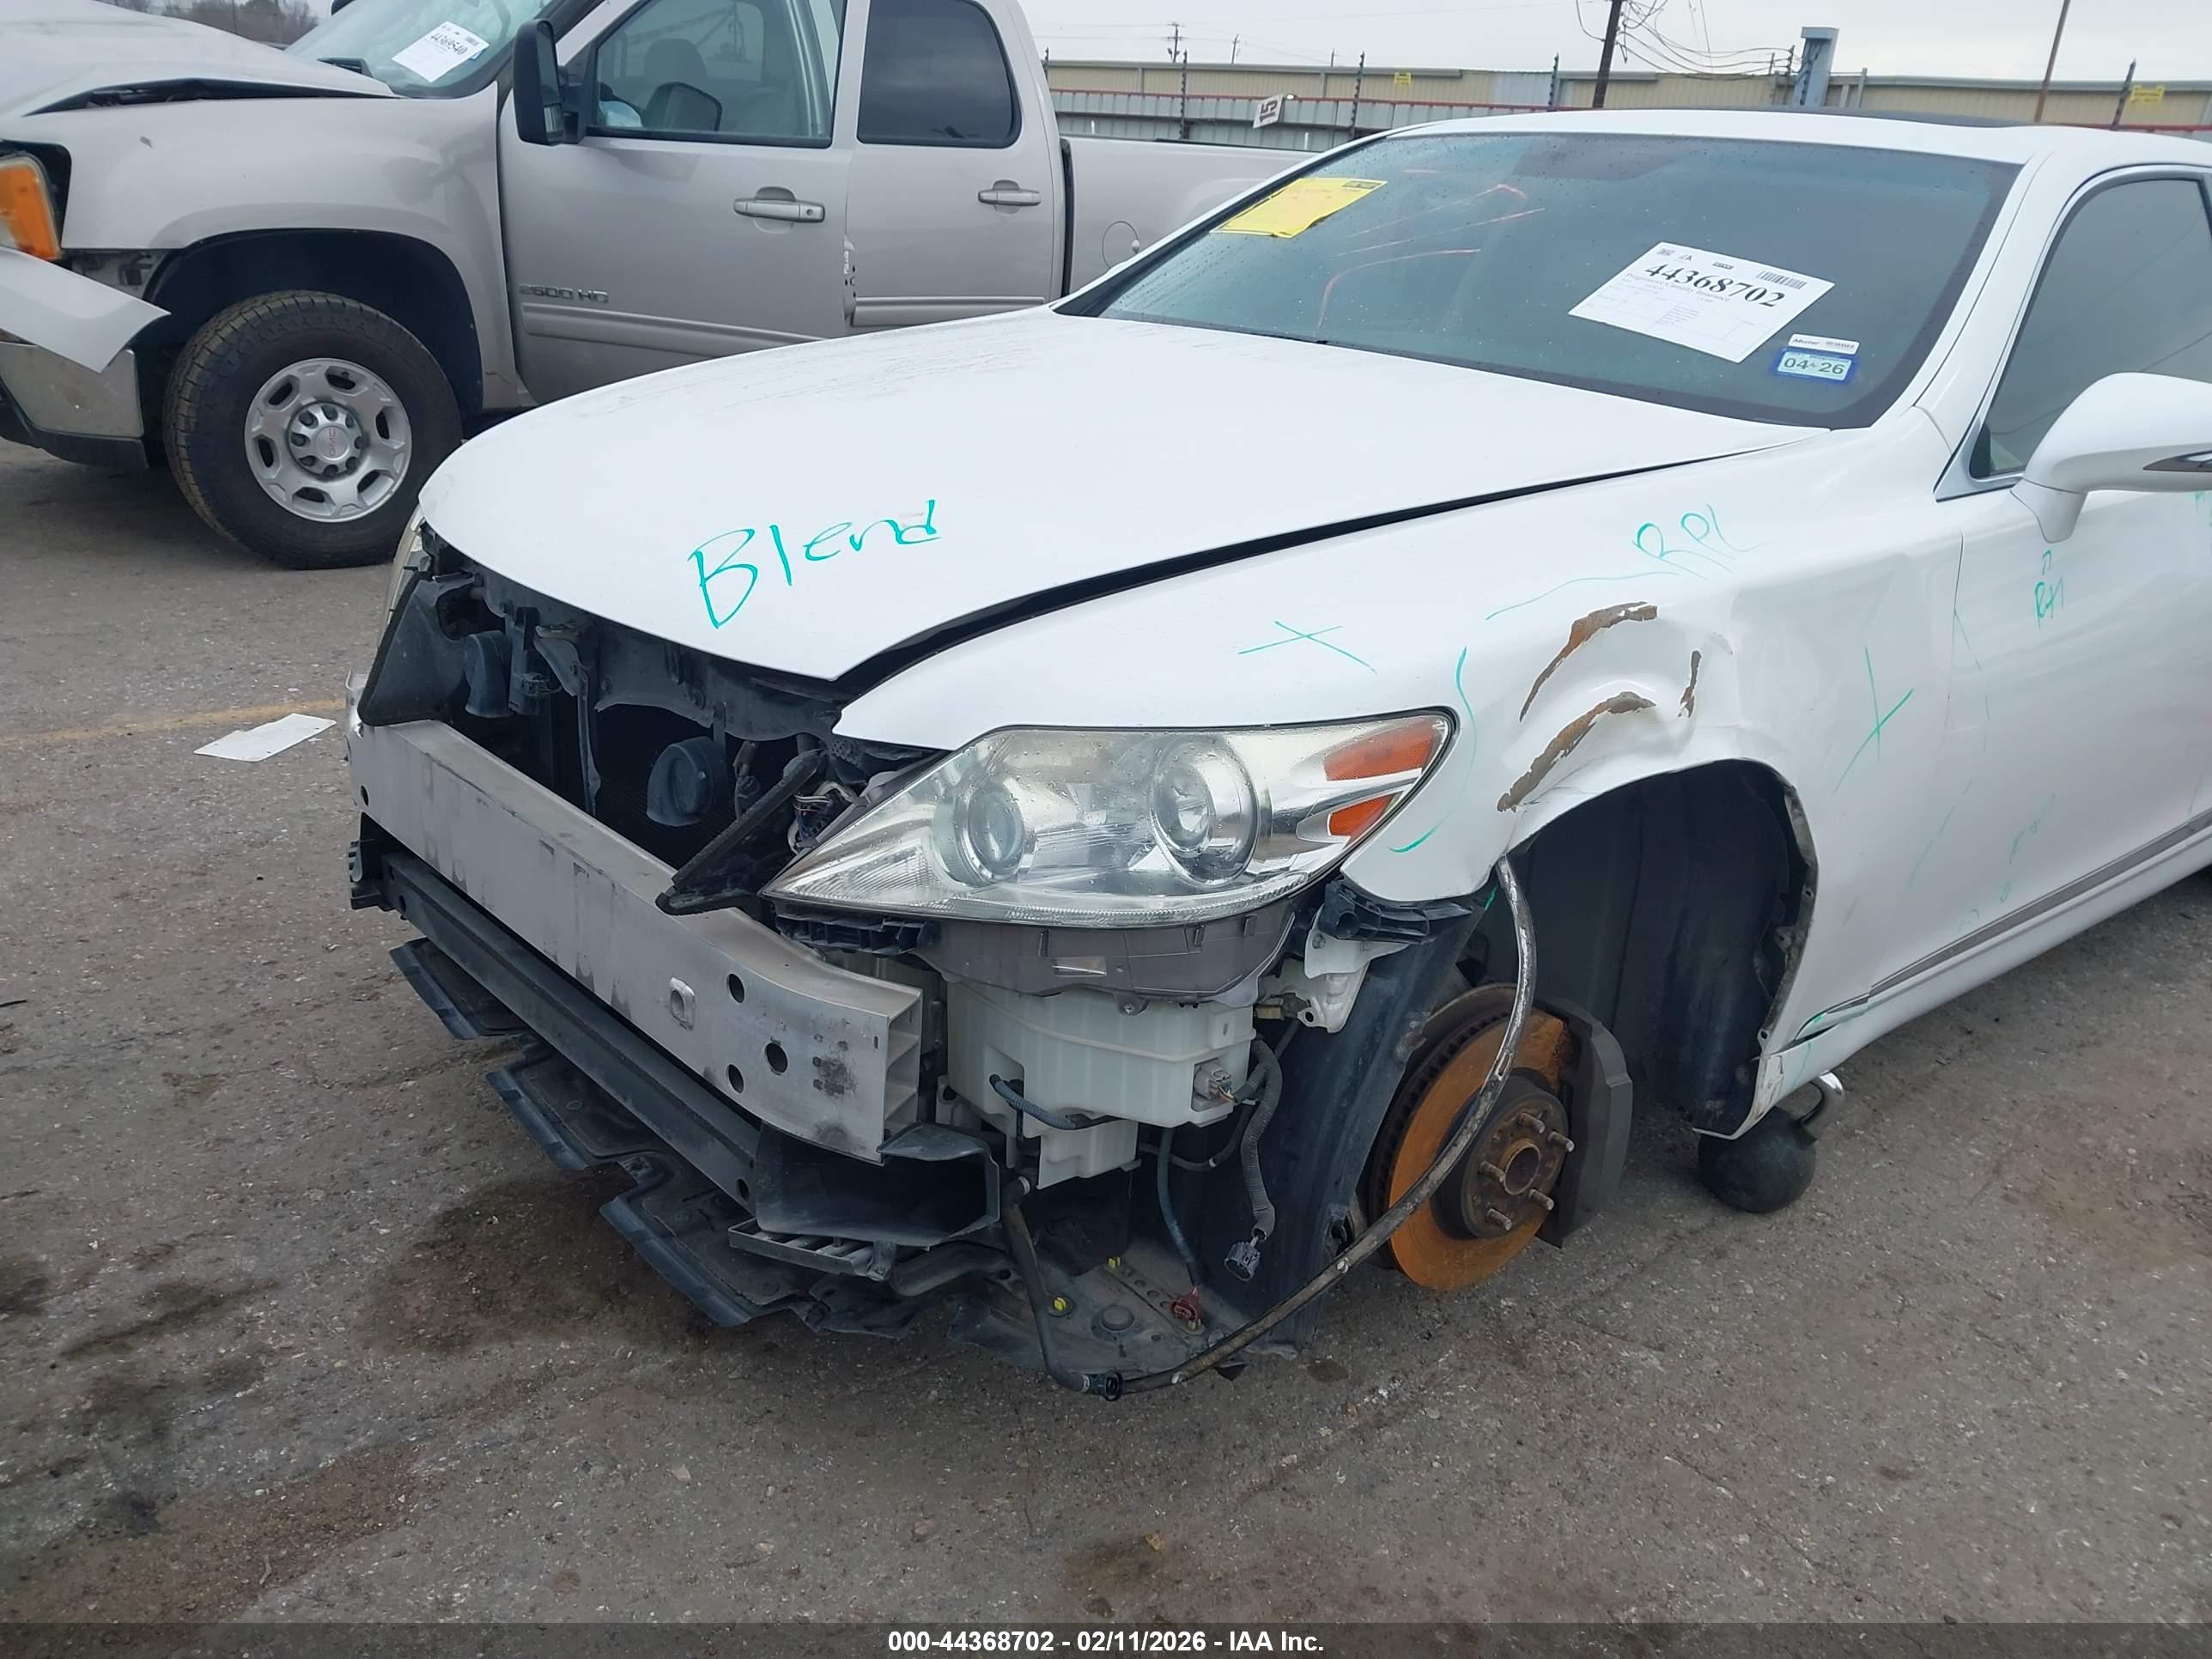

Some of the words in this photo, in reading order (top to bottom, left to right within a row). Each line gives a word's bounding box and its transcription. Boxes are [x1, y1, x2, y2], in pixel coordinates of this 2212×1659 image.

[1258, 100, 1279, 124] 15
[577, 288, 609, 303] HD
[1644, 263, 1786, 307] 44368702
[1784, 357, 1808, 369] 04
[1818, 362, 1845, 374] 26
[328, 428, 337, 456] GMC
[686, 498, 941, 629] Blend
